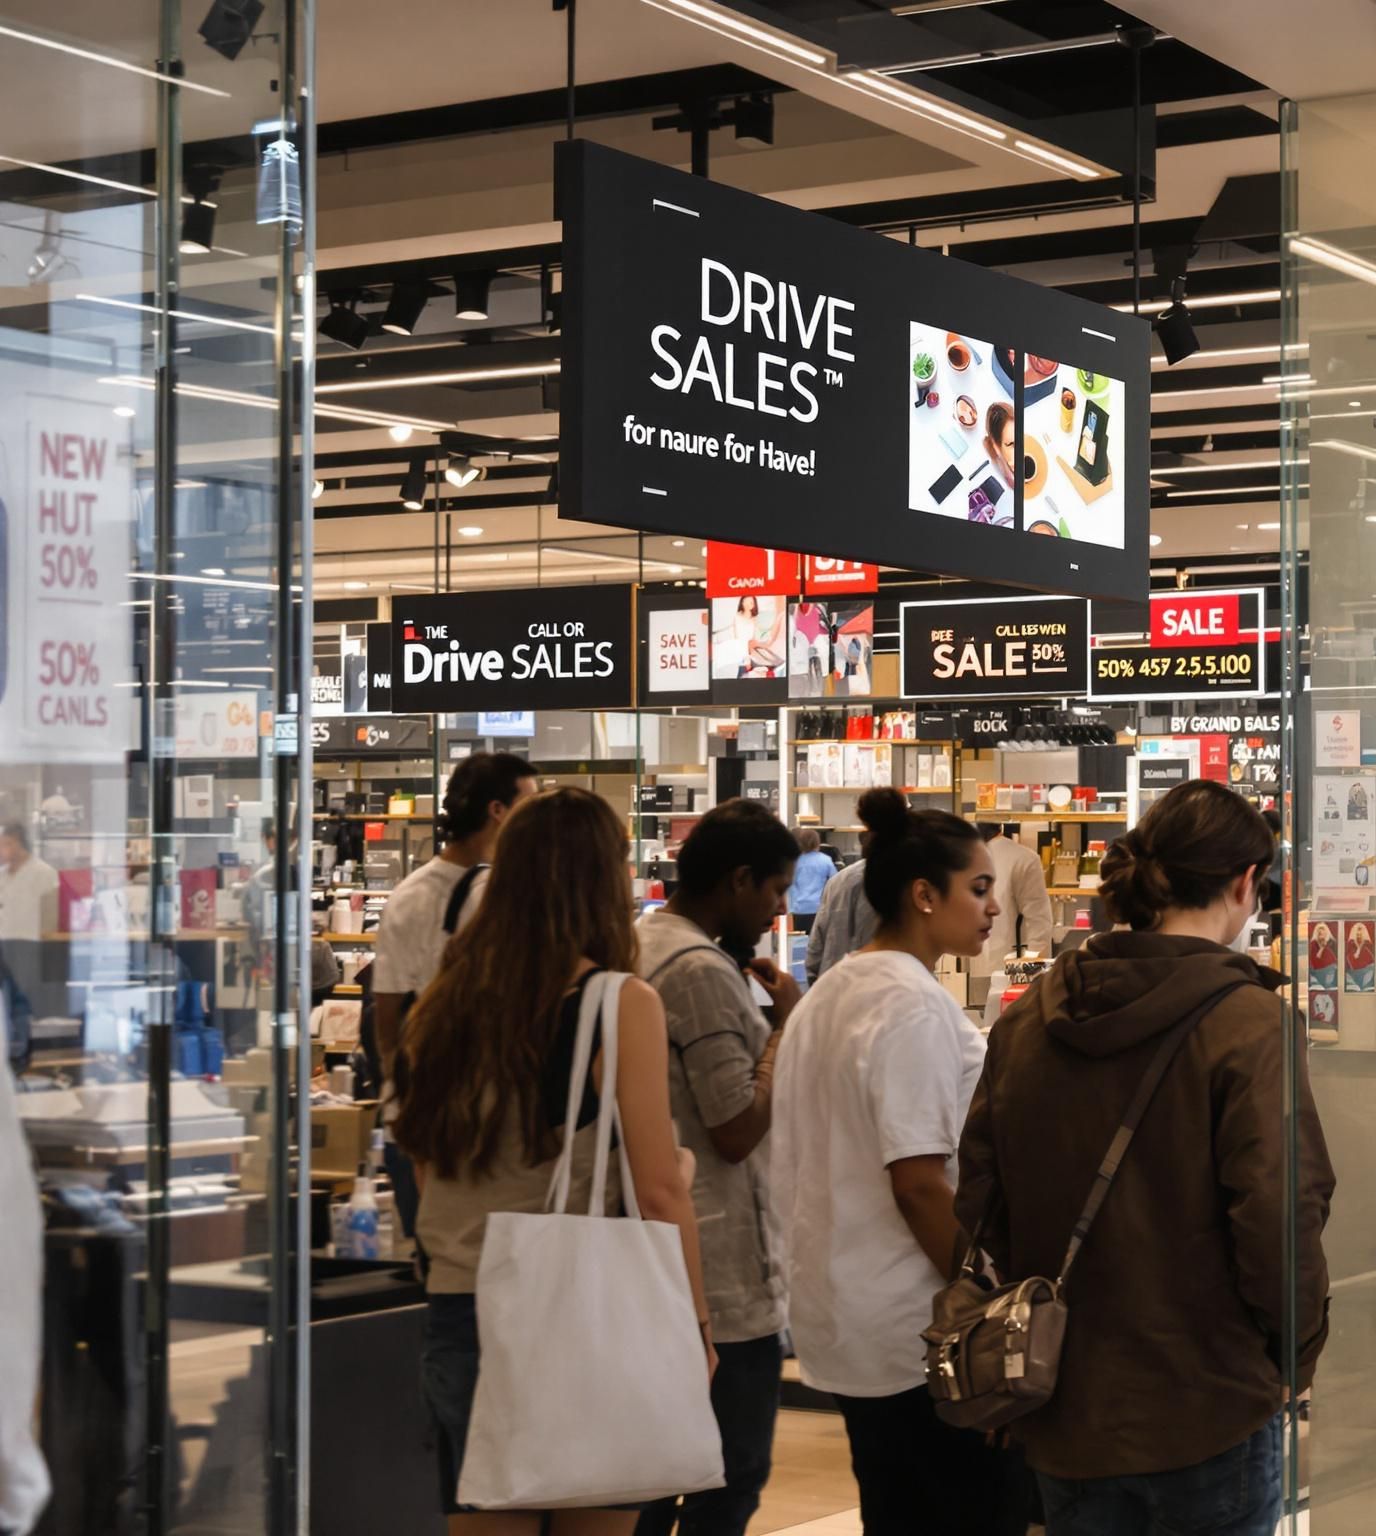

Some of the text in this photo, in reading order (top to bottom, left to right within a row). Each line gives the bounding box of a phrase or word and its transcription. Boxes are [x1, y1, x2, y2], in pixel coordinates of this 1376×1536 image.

[702, 257, 855, 362] DRIVE
[40, 432, 106, 481] NEW
[623, 415, 816, 477] for naure for Have!
[38, 490, 97, 536] HUT
[40, 543, 97, 590] 50%
[528, 623, 562, 638] CALL
[563, 622, 585, 637] OR
[660, 634, 697, 649] SAVE
[1162, 607, 1225, 637] SALE
[39, 640, 99, 687] 50%
[403, 639, 505, 684] Drive
[511, 641, 615, 679] SALES
[660, 654, 698, 670] SALE
[932, 641, 1027, 678] SALE
[1097, 658, 1135, 678] 50%
[38, 695, 107, 727] CANLS
